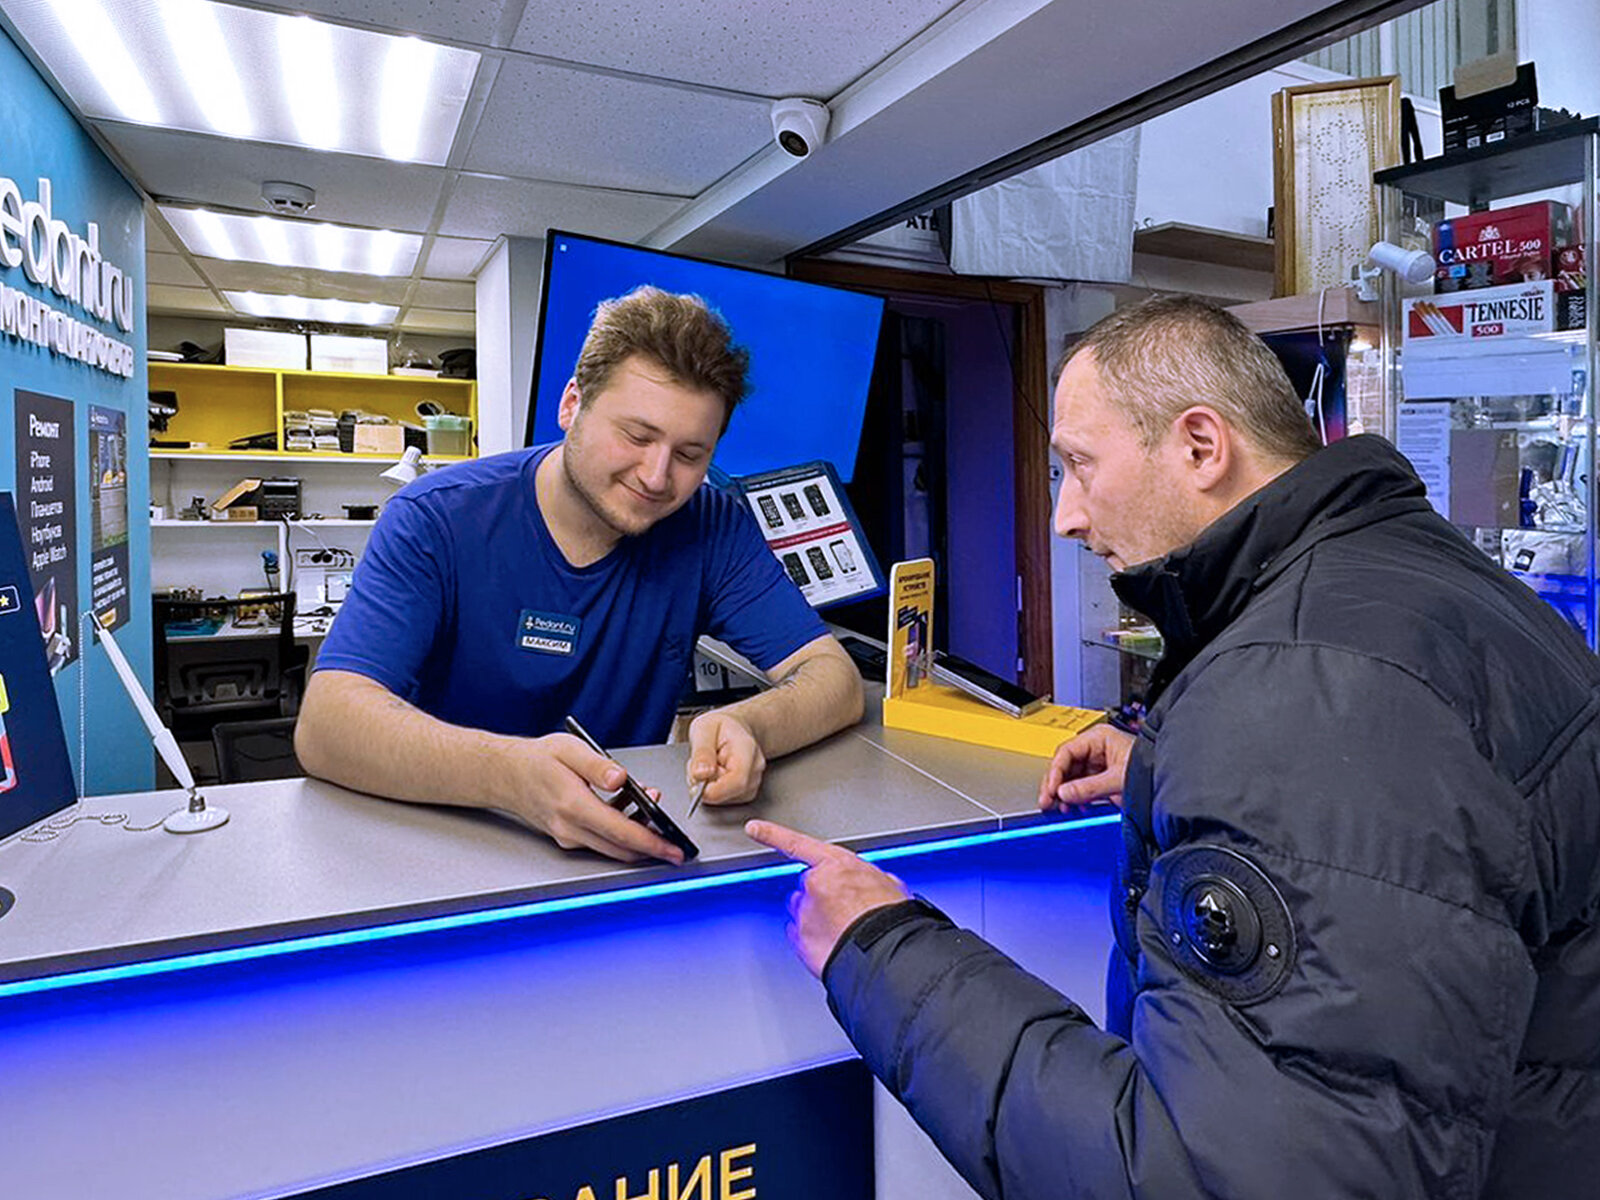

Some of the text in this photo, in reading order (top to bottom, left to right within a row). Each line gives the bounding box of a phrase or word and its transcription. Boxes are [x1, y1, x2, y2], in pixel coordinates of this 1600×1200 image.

[1439, 240, 1517, 265] CARTEL
[1519, 239, 1542, 251] 500
[1464, 297, 1545, 322] TENNESIE
[1477, 325, 1500, 335] 500
[29, 414, 60, 438] Ремонт
[30, 451, 51, 468] iPhone
[32, 548, 50, 571] Apple
[701, 662, 718, 676] 10
